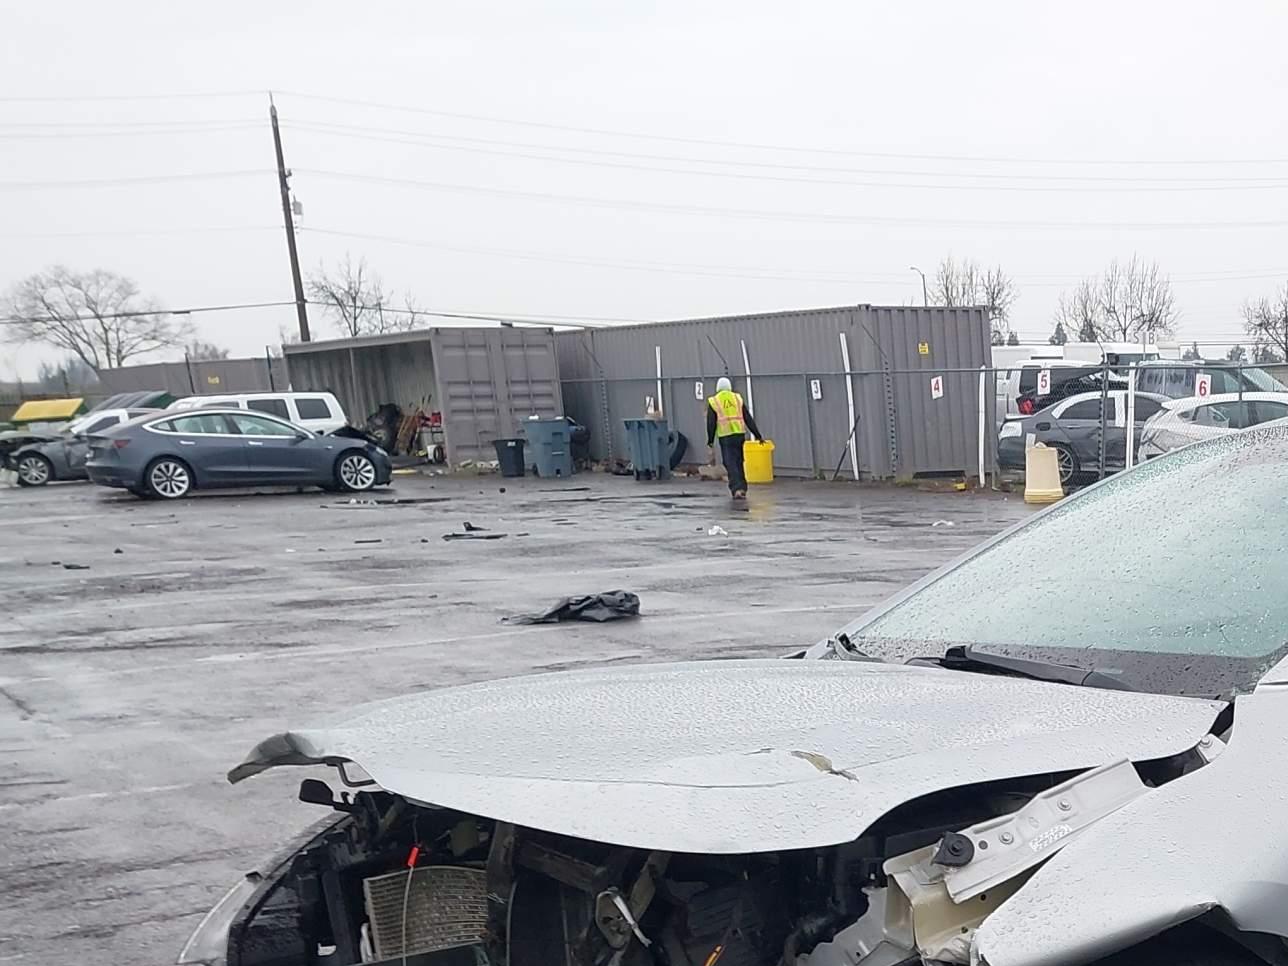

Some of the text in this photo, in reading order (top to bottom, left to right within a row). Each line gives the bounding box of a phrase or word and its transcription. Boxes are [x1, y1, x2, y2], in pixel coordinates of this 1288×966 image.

[813, 381, 819, 394] 3
[934, 378, 940, 393] 4
[1040, 374, 1047, 388] 5
[1199, 380, 1207, 396] 6
